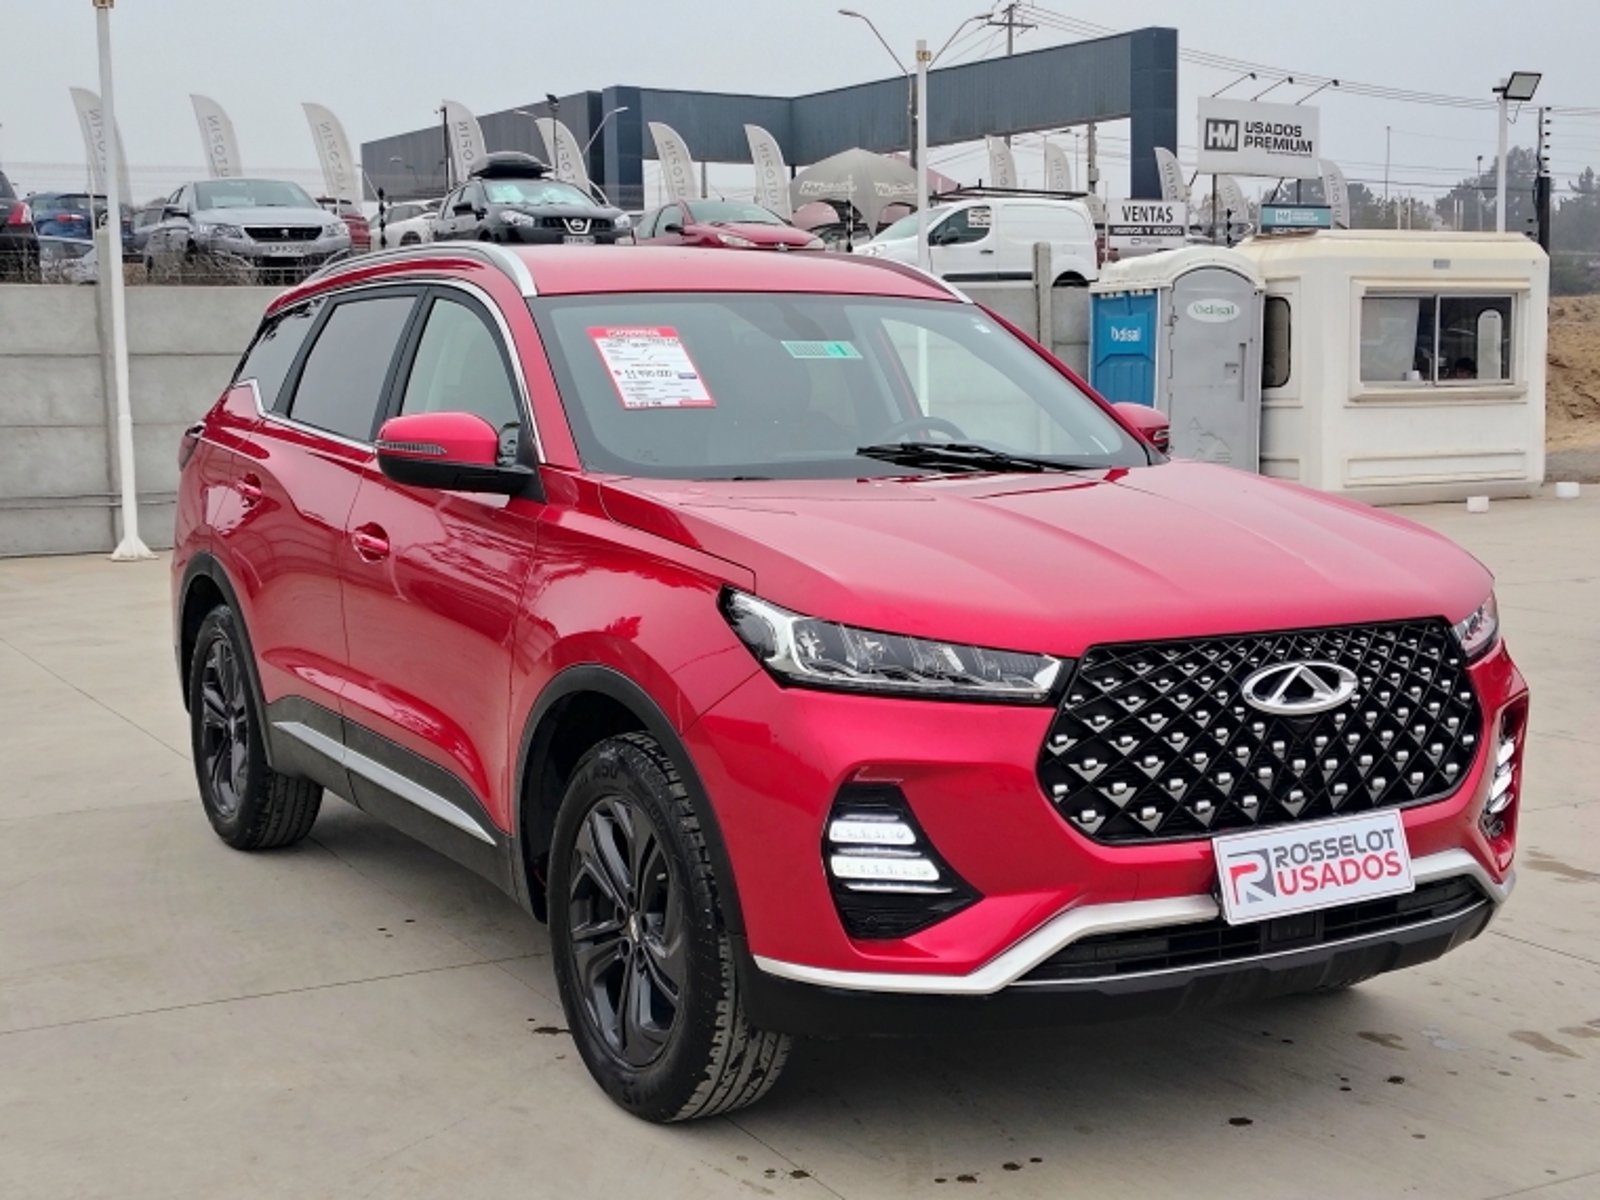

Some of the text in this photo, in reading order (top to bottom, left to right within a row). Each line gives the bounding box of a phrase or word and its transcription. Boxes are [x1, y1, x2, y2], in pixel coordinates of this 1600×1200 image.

[1206, 120, 1237, 149] HM
[1244, 121, 1302, 138] USADOS
[1244, 135, 1313, 153] PREMIUM
[1121, 205, 1174, 223] VENTAS
[1273, 828, 1395, 869] ROSSELOT
[1277, 851, 1403, 897] USADOS
